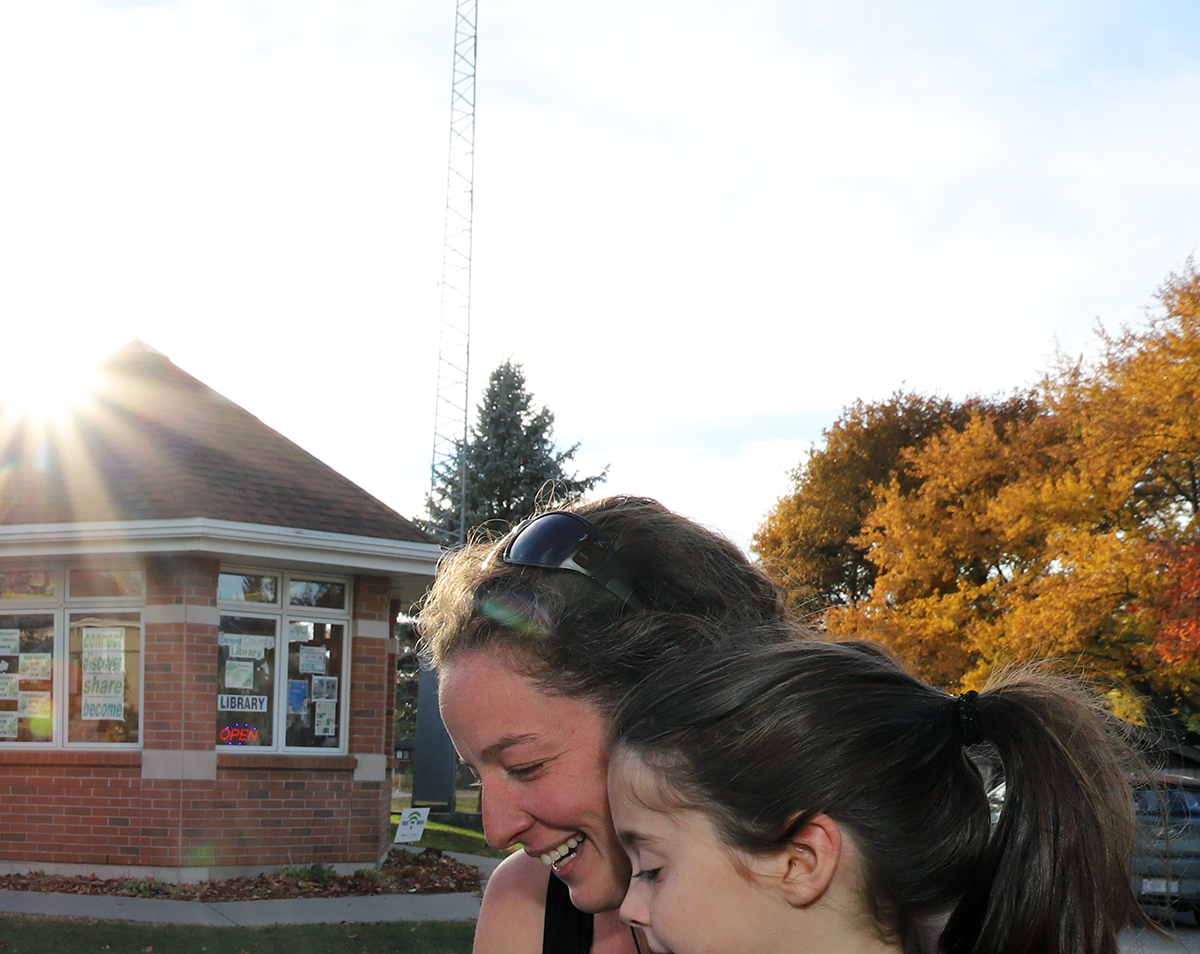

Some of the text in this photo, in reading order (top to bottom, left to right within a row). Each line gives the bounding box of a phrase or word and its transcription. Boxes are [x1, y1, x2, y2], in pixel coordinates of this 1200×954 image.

[84, 630, 123, 648] connect
[244, 637, 274, 646] County
[231, 647, 262, 658] Library
[84, 652, 122, 671] discover
[84, 676, 122, 694] share
[83, 698, 122, 717] become
[220, 696, 265, 710] LIBRARY
[220, 728, 258, 741] OPEN
